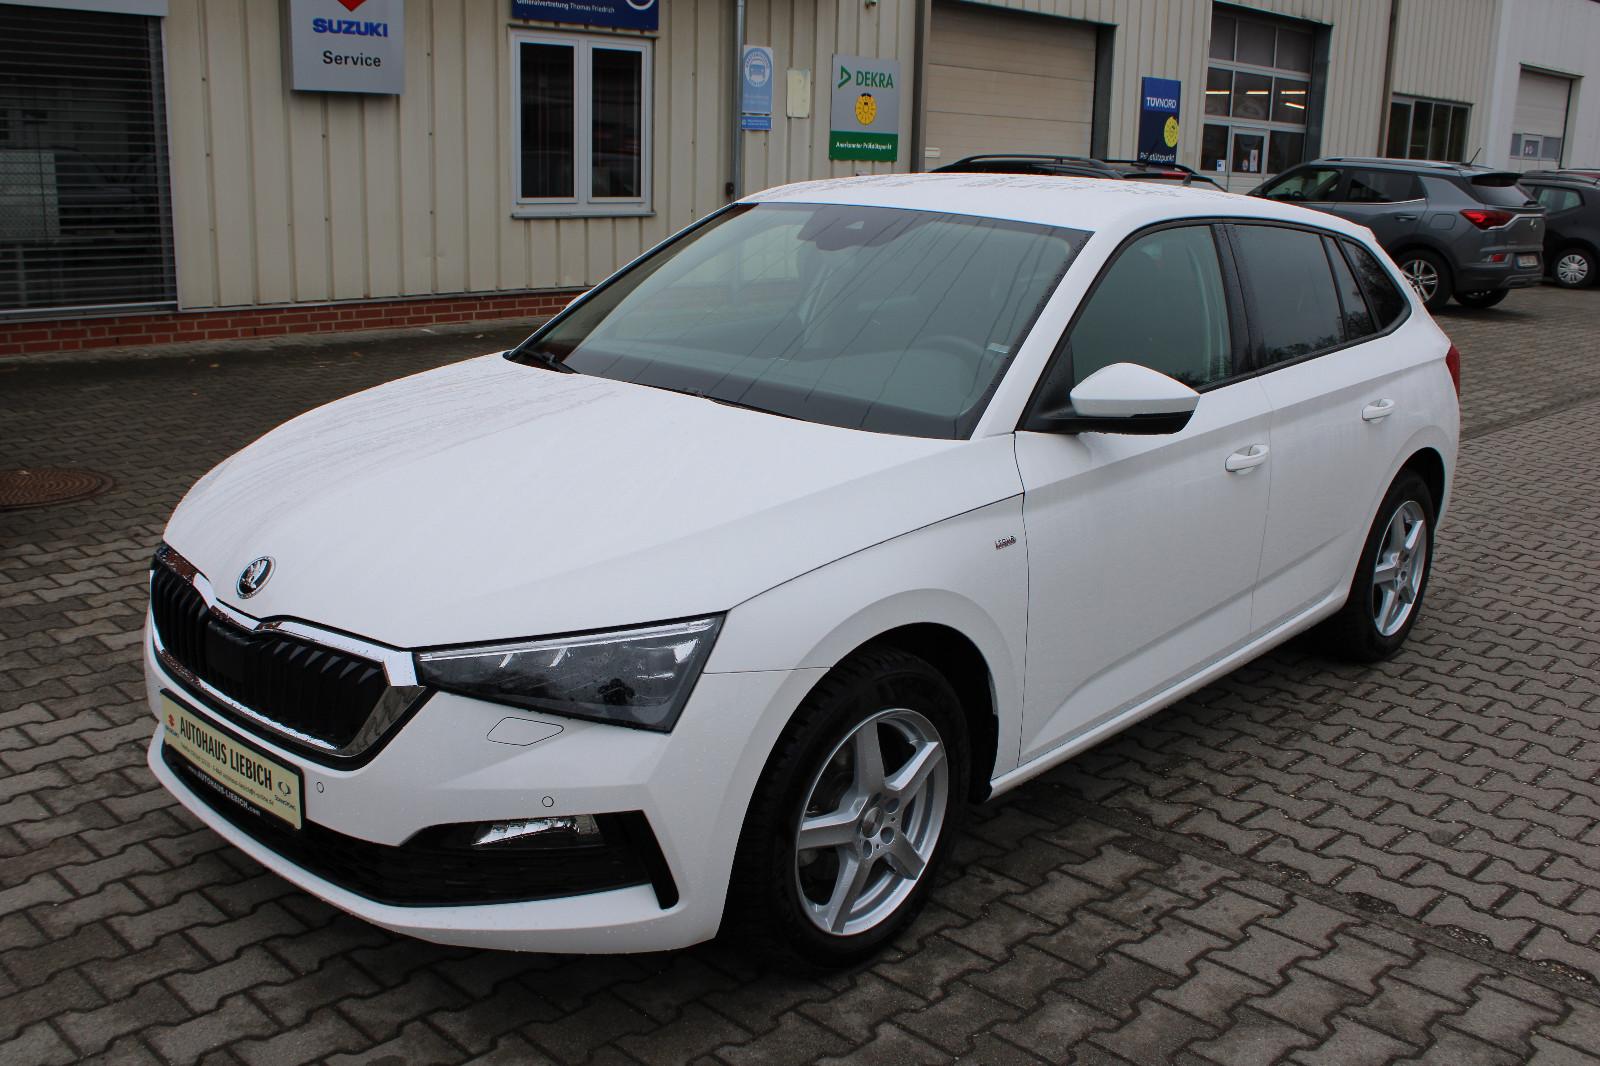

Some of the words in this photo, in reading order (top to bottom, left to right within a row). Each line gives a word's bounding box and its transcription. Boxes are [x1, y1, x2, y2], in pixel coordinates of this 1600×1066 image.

[570, 3, 591, 11] Thomas
[592, 5, 615, 13] Friedrich
[312, 17, 388, 37] SUZUKI
[322, 50, 382, 67] Service
[855, 70, 894, 89] DEKRA
[180, 716, 227, 765] AUTOHAUS
[230, 748, 273, 791] LIEBICH
